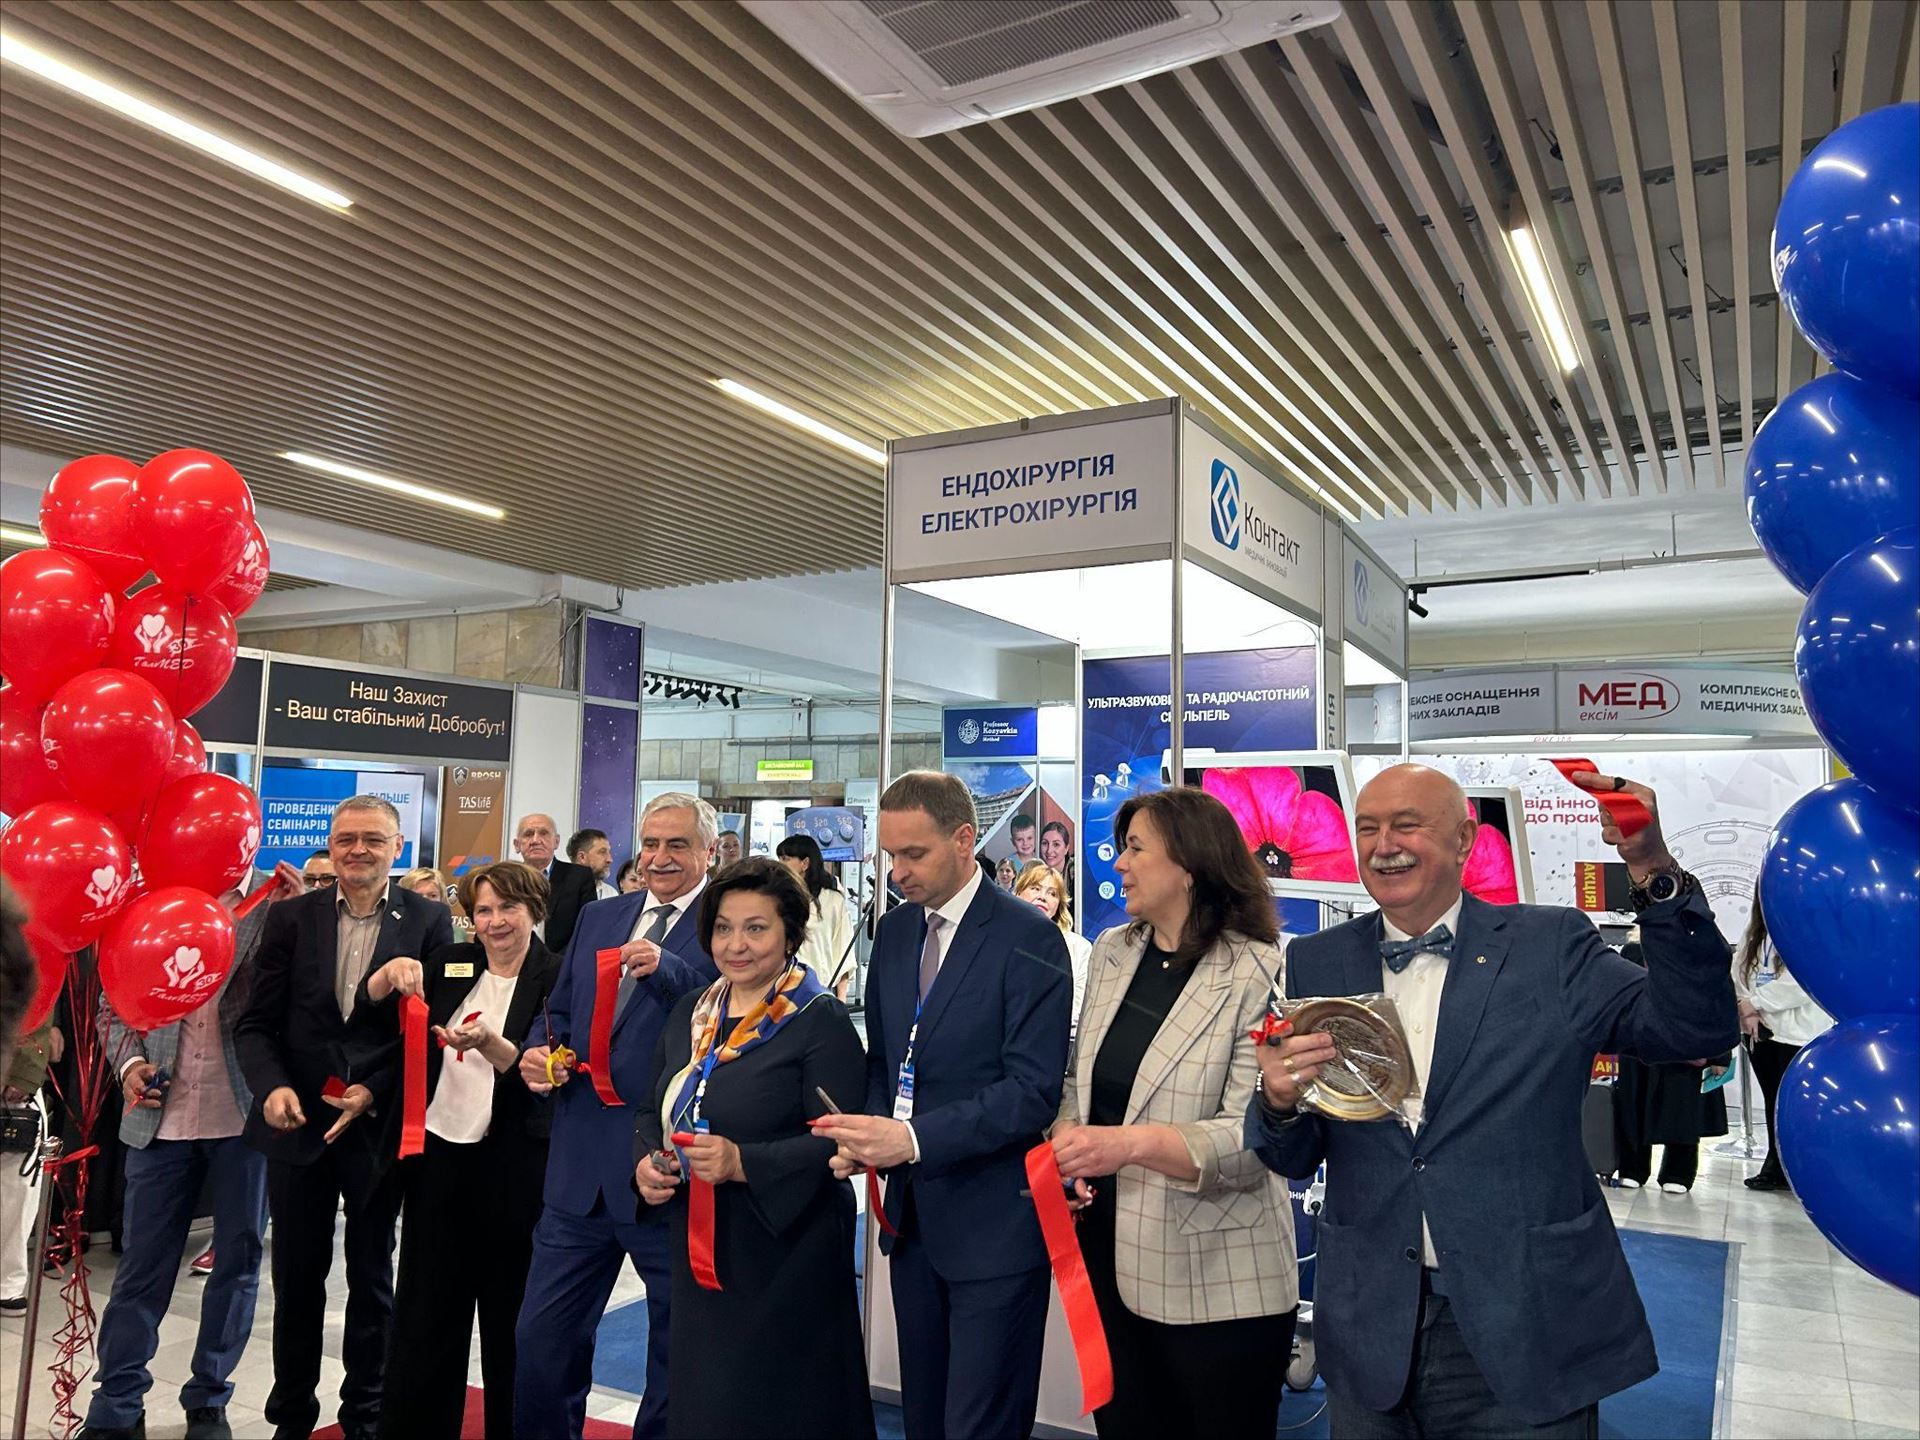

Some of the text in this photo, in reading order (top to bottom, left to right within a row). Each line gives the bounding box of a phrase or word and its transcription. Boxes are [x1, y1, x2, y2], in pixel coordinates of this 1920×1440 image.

[942, 453, 1115, 498] ЕНДОХІРУРГІЯ
[921, 488, 1137, 535] ЕЛЕКТРОХІРУРГІЯ
[1244, 502, 1301, 566] Контакт
[350, 681, 448, 708] Наш Захист
[1088, 685, 1310, 709] УЛЬТРАЗВУКОВ ТА РАДІОЧАСТОТНИЙ
[1410, 687, 1540, 706] ЕКСНЕ ОСНАЩЕННЯ
[1579, 681, 1667, 710] МЕД
[1700, 684, 1789, 698] КОМПЛЕКСНЕ
[1432, 705, 1501, 719] ЗАКЛАДІВ
[1700, 700, 1779, 713] МЕДИЧНИХ
[287, 699, 327, 721] Ваш
[333, 707, 425, 729] стабільний
[429, 713, 505, 738] Добробут!
[1160, 709, 1230, 723] СЛЬПЕЛЬ
[1580, 709, 1618, 721] ексім
[459, 796, 477, 809] TAS
[1524, 796, 1597, 810] від інно
[268, 803, 338, 817] ПРОВЕДЕНИ
[267, 818, 328, 831] СЕМІНАРІВ
[1525, 813, 1600, 825] до прак
[266, 834, 280, 846] ТА
[1583, 862, 1597, 908] АКЦІЯ!
